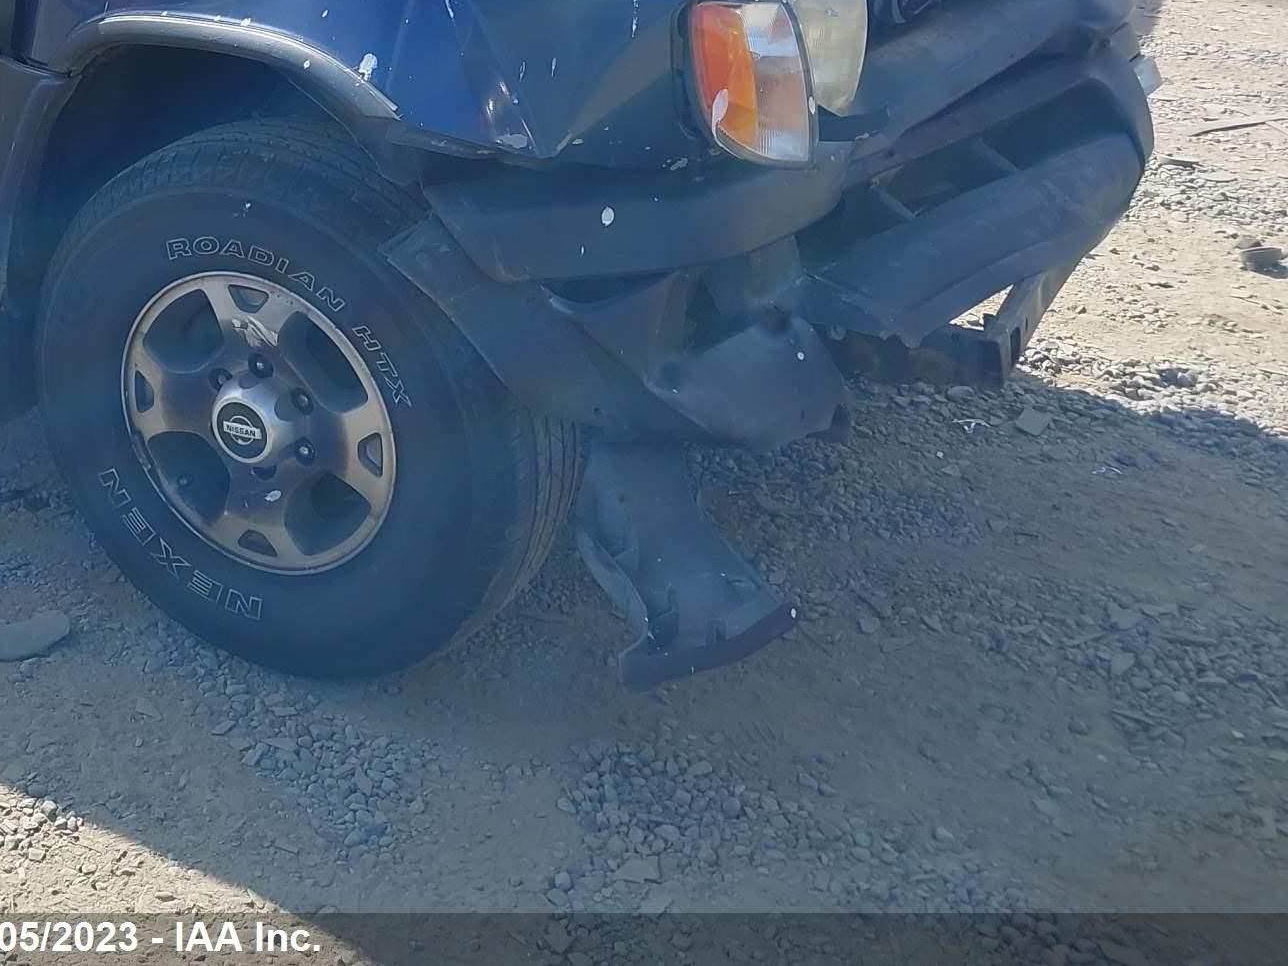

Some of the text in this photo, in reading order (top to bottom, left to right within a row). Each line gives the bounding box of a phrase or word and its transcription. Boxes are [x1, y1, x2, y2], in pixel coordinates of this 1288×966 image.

[166, 237, 346, 312] ROADIAN
[352, 325, 412, 407] HTX
[226, 424, 255, 437] NISSAN
[97, 468, 262, 620] NEXEN
